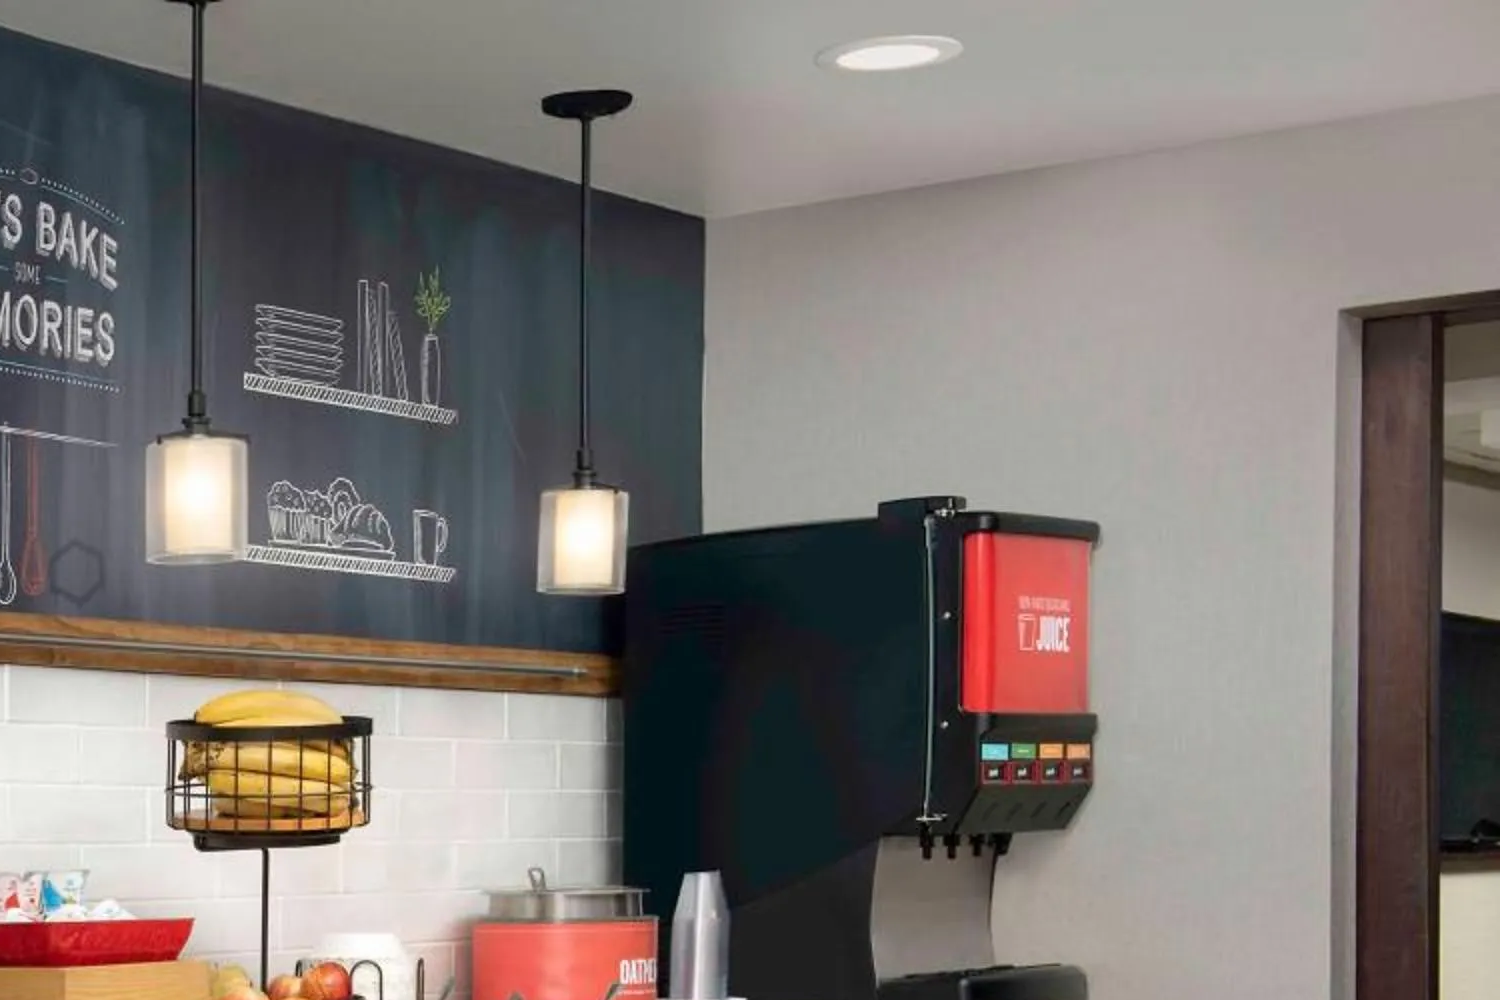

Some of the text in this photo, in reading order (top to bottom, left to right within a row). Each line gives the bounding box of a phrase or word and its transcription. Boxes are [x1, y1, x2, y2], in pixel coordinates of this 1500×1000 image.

[35, 201, 119, 292] BAKE
[14, 261, 42, 285] SOME
[1036, 615, 1071, 652] JUICE
